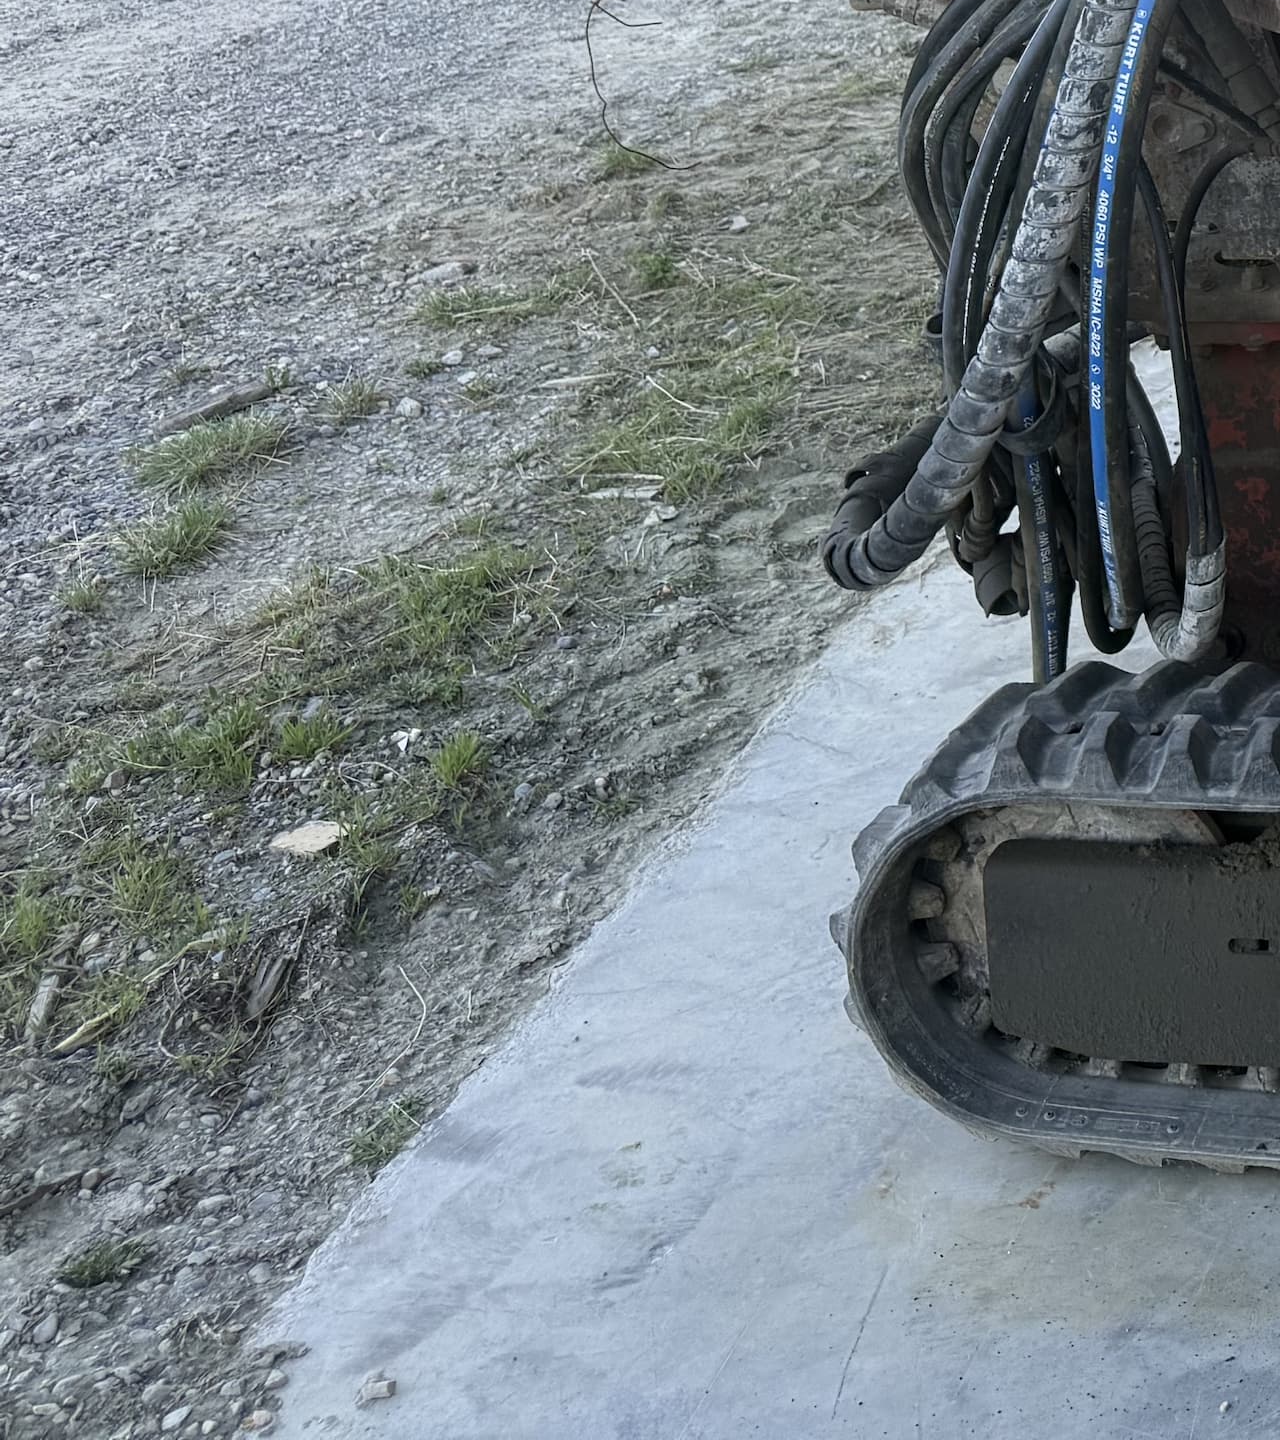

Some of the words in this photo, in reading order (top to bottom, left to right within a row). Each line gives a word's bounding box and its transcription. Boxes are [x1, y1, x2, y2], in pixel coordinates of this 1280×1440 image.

[1122, 21, 1144, 70] KURT
[1113, 72, 1131, 115] TUFF
[1106, 124, 1119, 145] -12
[1103, 154, 1115, 181] 3/4"
[1097, 189, 1110, 222] 4060
[1095, 222, 1107, 245] PSI
[1093, 247, 1105, 269] WP
[1091, 276, 1103, 314] MSHA
